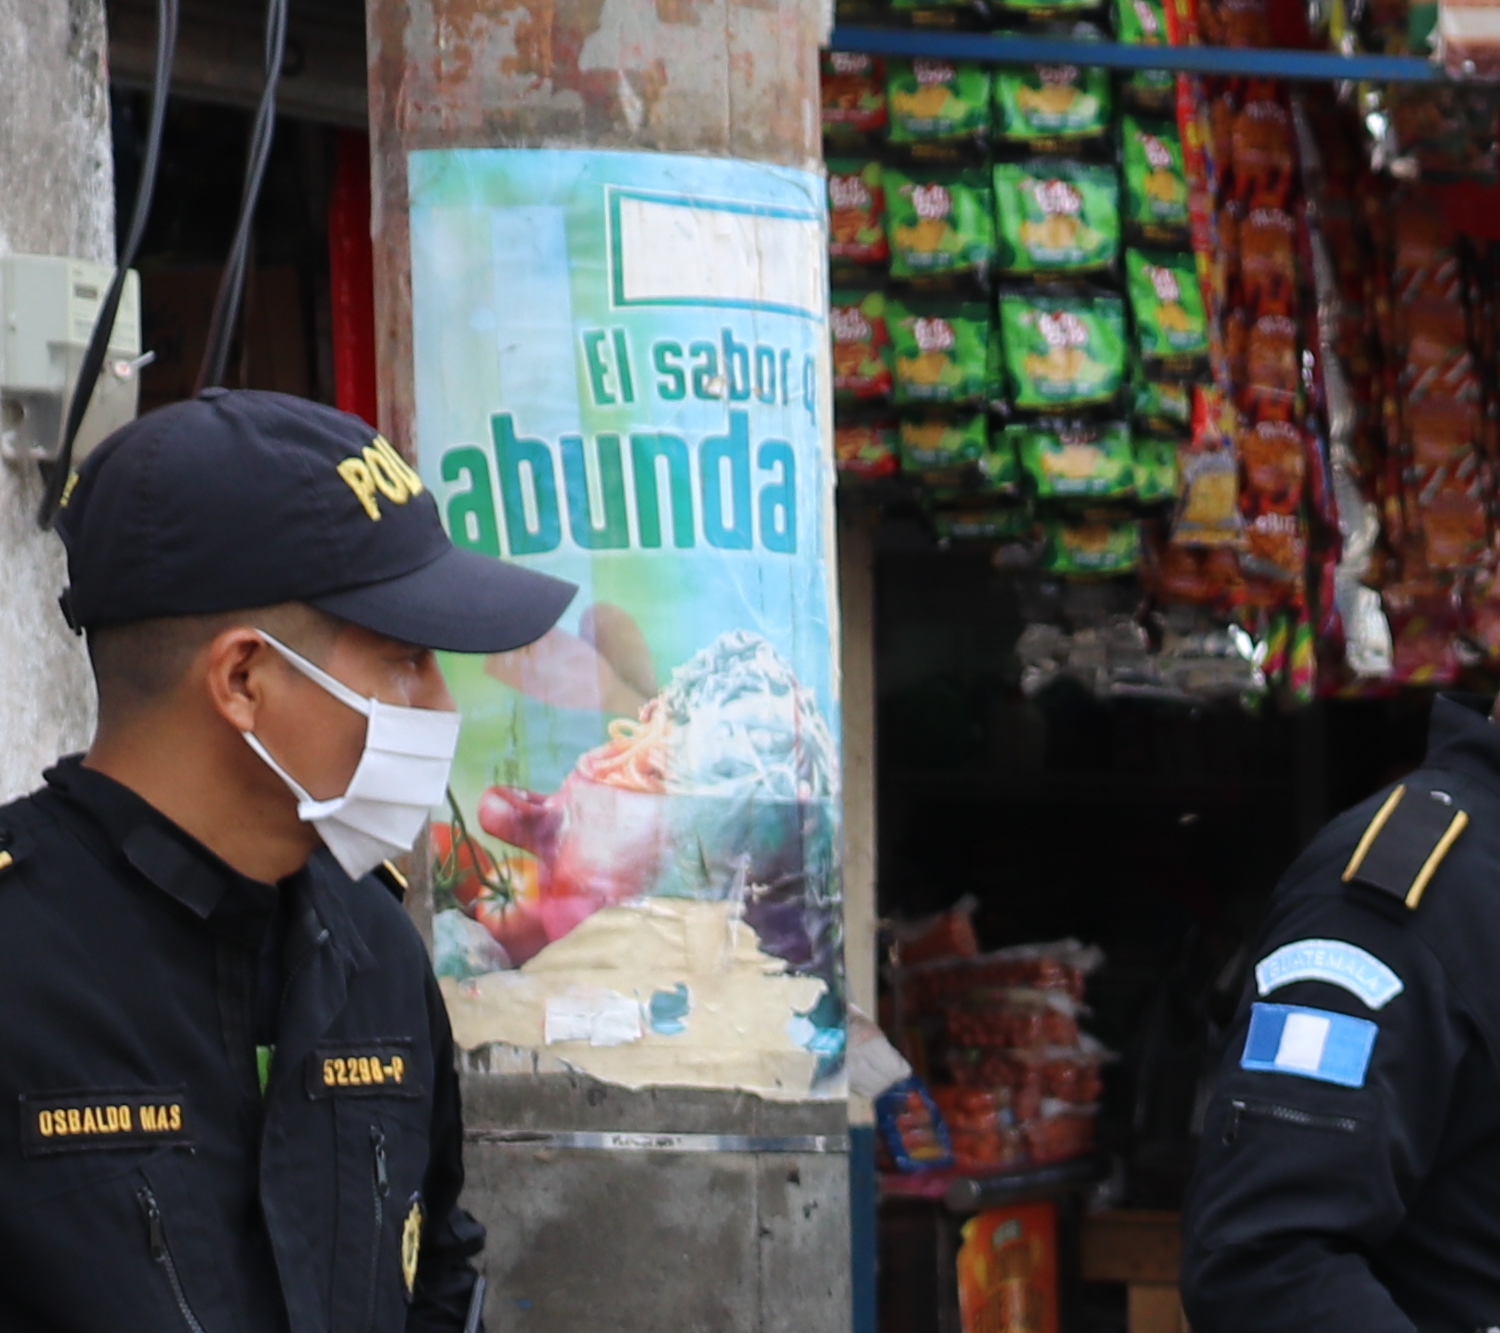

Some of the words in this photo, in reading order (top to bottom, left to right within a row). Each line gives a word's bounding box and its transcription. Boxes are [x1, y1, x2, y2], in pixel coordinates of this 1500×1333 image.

[583, 327, 635, 406] El
[653, 327, 792, 406] sabor
[440, 410, 798, 557] abunda
[1267, 949, 1380, 993] GUATEMALA
[38, 1107, 132, 1136] OSBALDO
[139, 1104, 182, 1132] MAS
